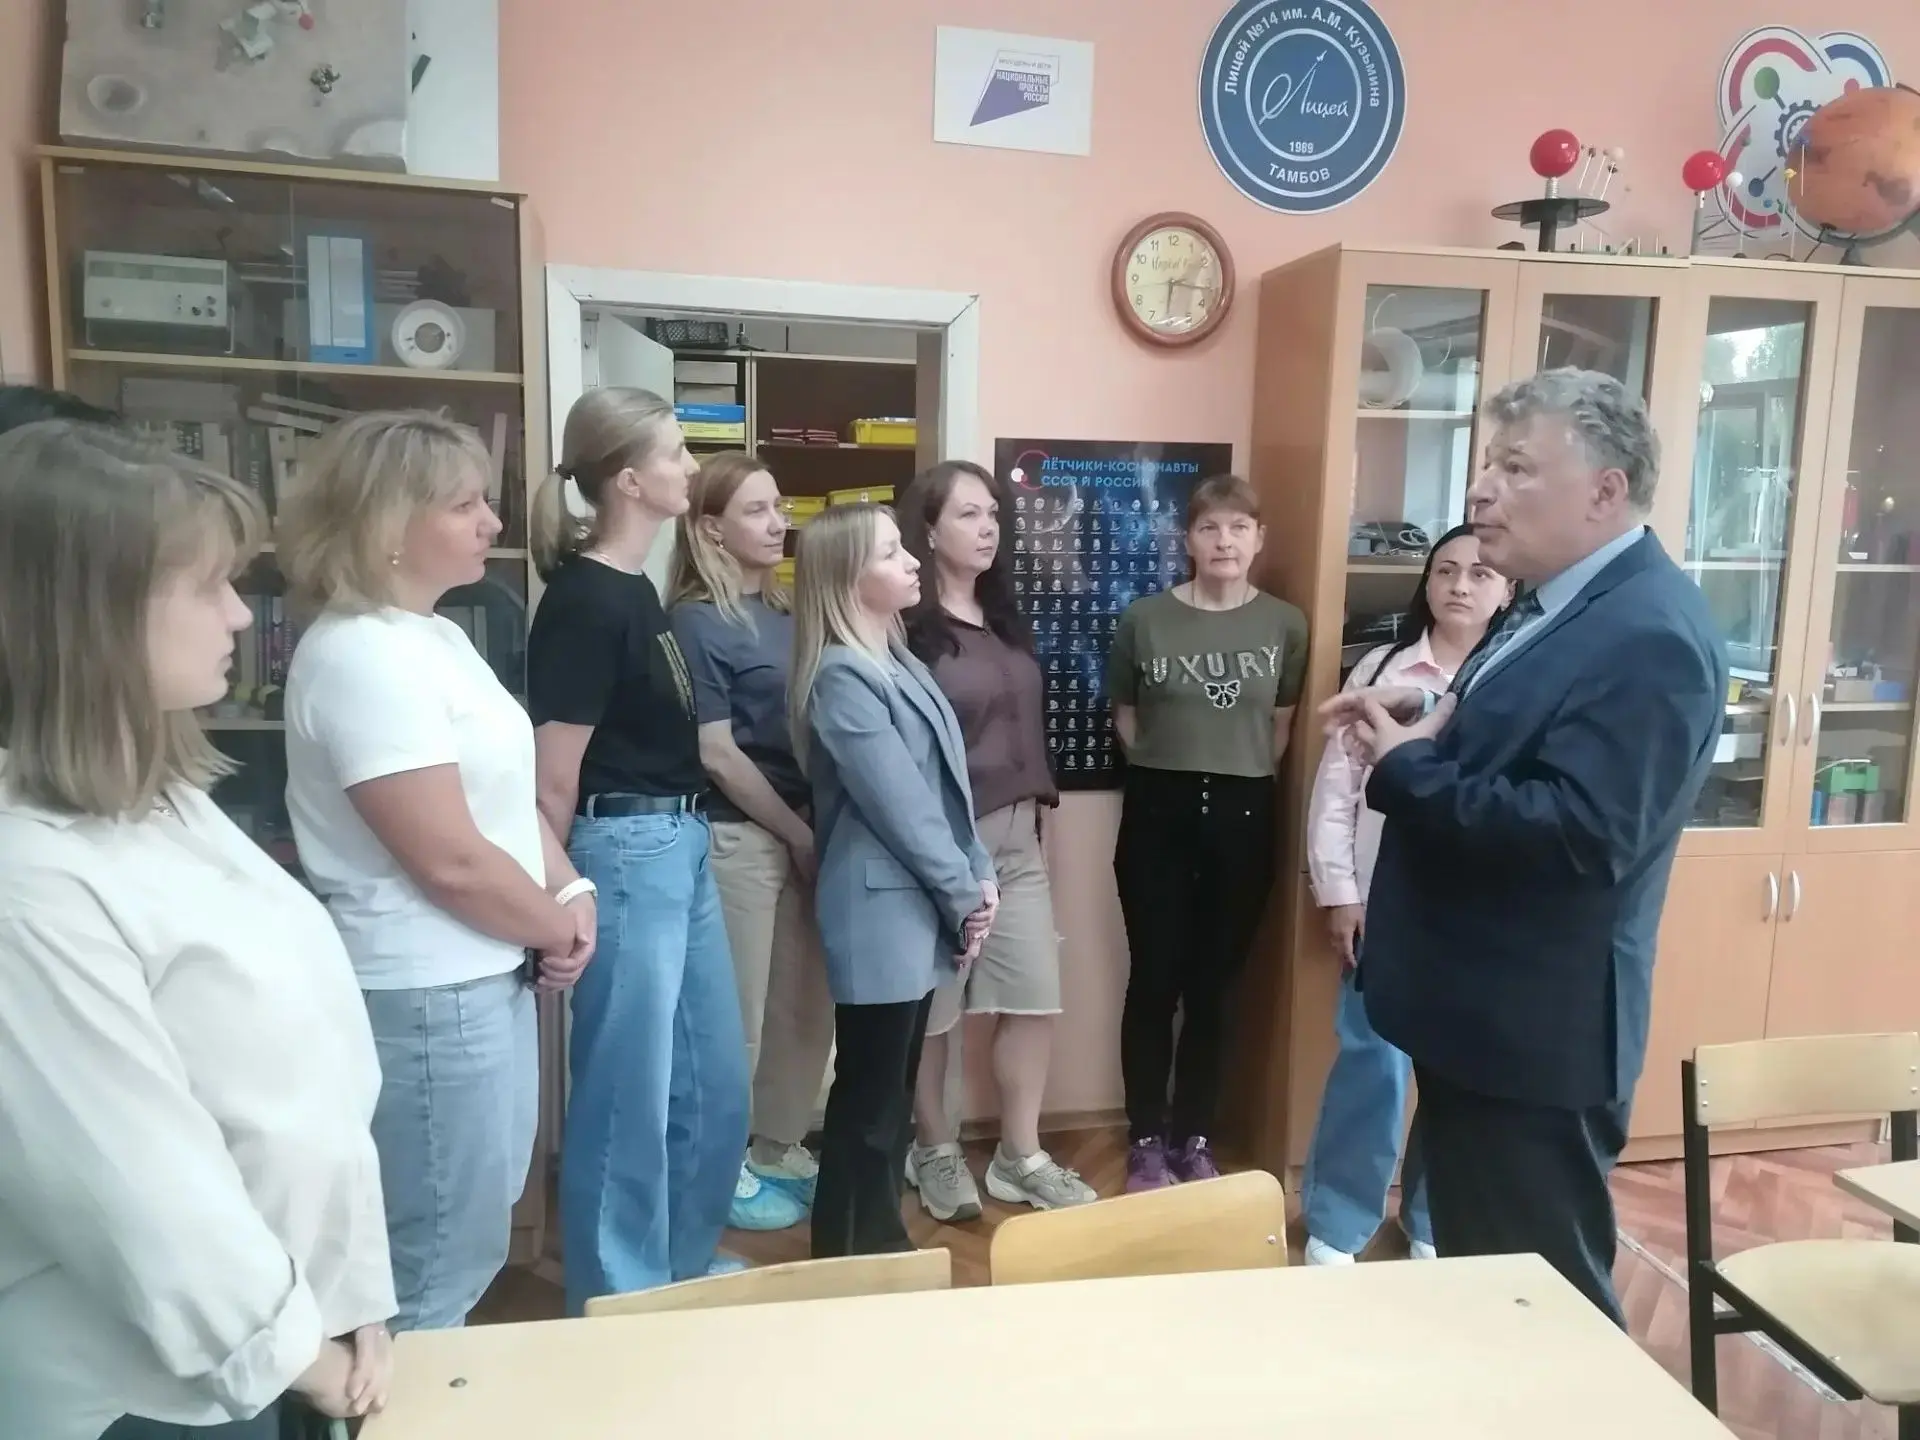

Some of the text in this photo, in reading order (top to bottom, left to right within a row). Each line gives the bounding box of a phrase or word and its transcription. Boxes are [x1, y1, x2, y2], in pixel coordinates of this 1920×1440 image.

[1225, 39, 1251, 95] Лицей
[1246, 14, 1279, 41] №14
[1282, 8, 1308, 21] им.
[1344, 25, 1380, 108] Кузьмина
[996, 71, 1049, 85] НАЦИОНАЛЬНЫЕ
[1269, 162, 1331, 184] ТАМБОВ
[1150, 240, 1159, 251] 11
[1168, 234, 1180, 247] 12
[1136, 254, 1147, 265] 10
[1131, 273, 1139, 285] 9
[1136, 294, 1143, 306] 8
[1198, 299, 1205, 308] 4
[1148, 310, 1156, 320] 7
[1041, 475, 1077, 487] СССР
[1081, 475, 1091, 487] И
